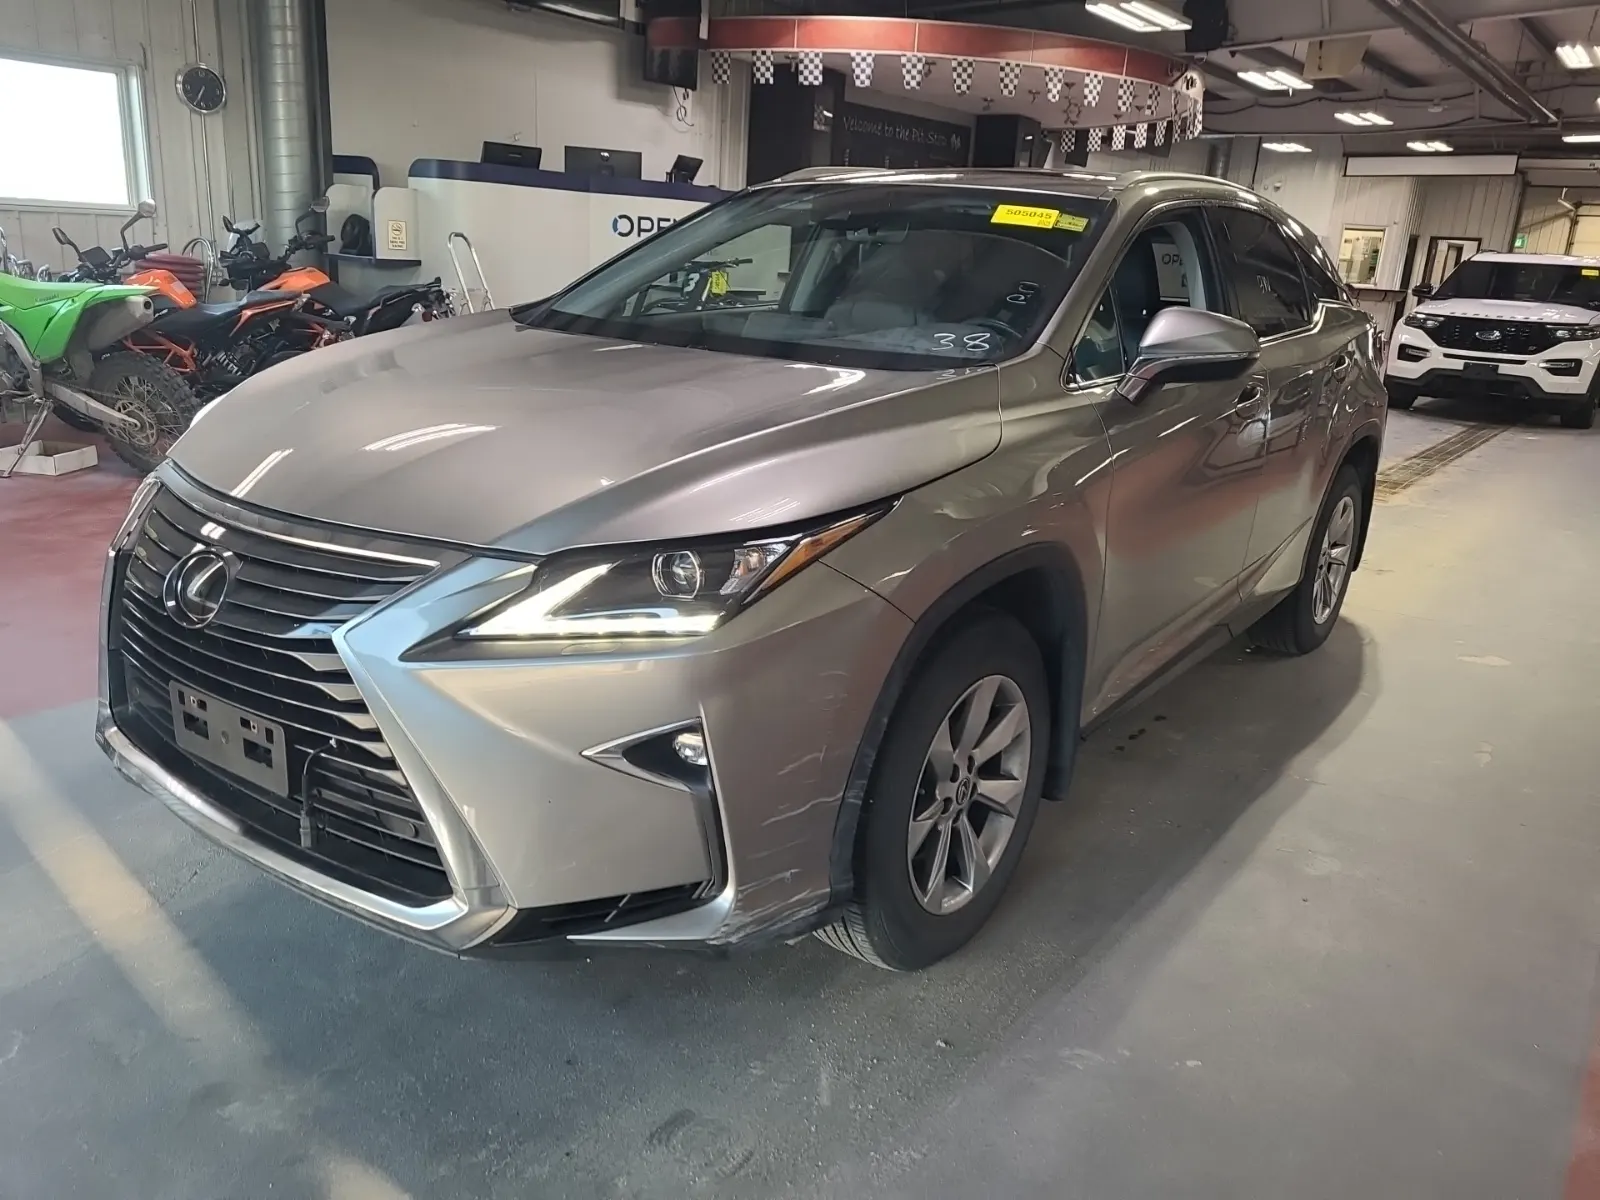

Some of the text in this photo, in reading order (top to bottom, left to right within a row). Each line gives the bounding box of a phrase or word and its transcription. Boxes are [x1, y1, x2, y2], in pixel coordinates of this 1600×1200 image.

[884, 122, 894, 137] to
[895, 125, 909, 141] the
[1005, 208, 1053, 220] 505045
[612, 214, 678, 238] OPE
[684, 273, 700, 292] 3
